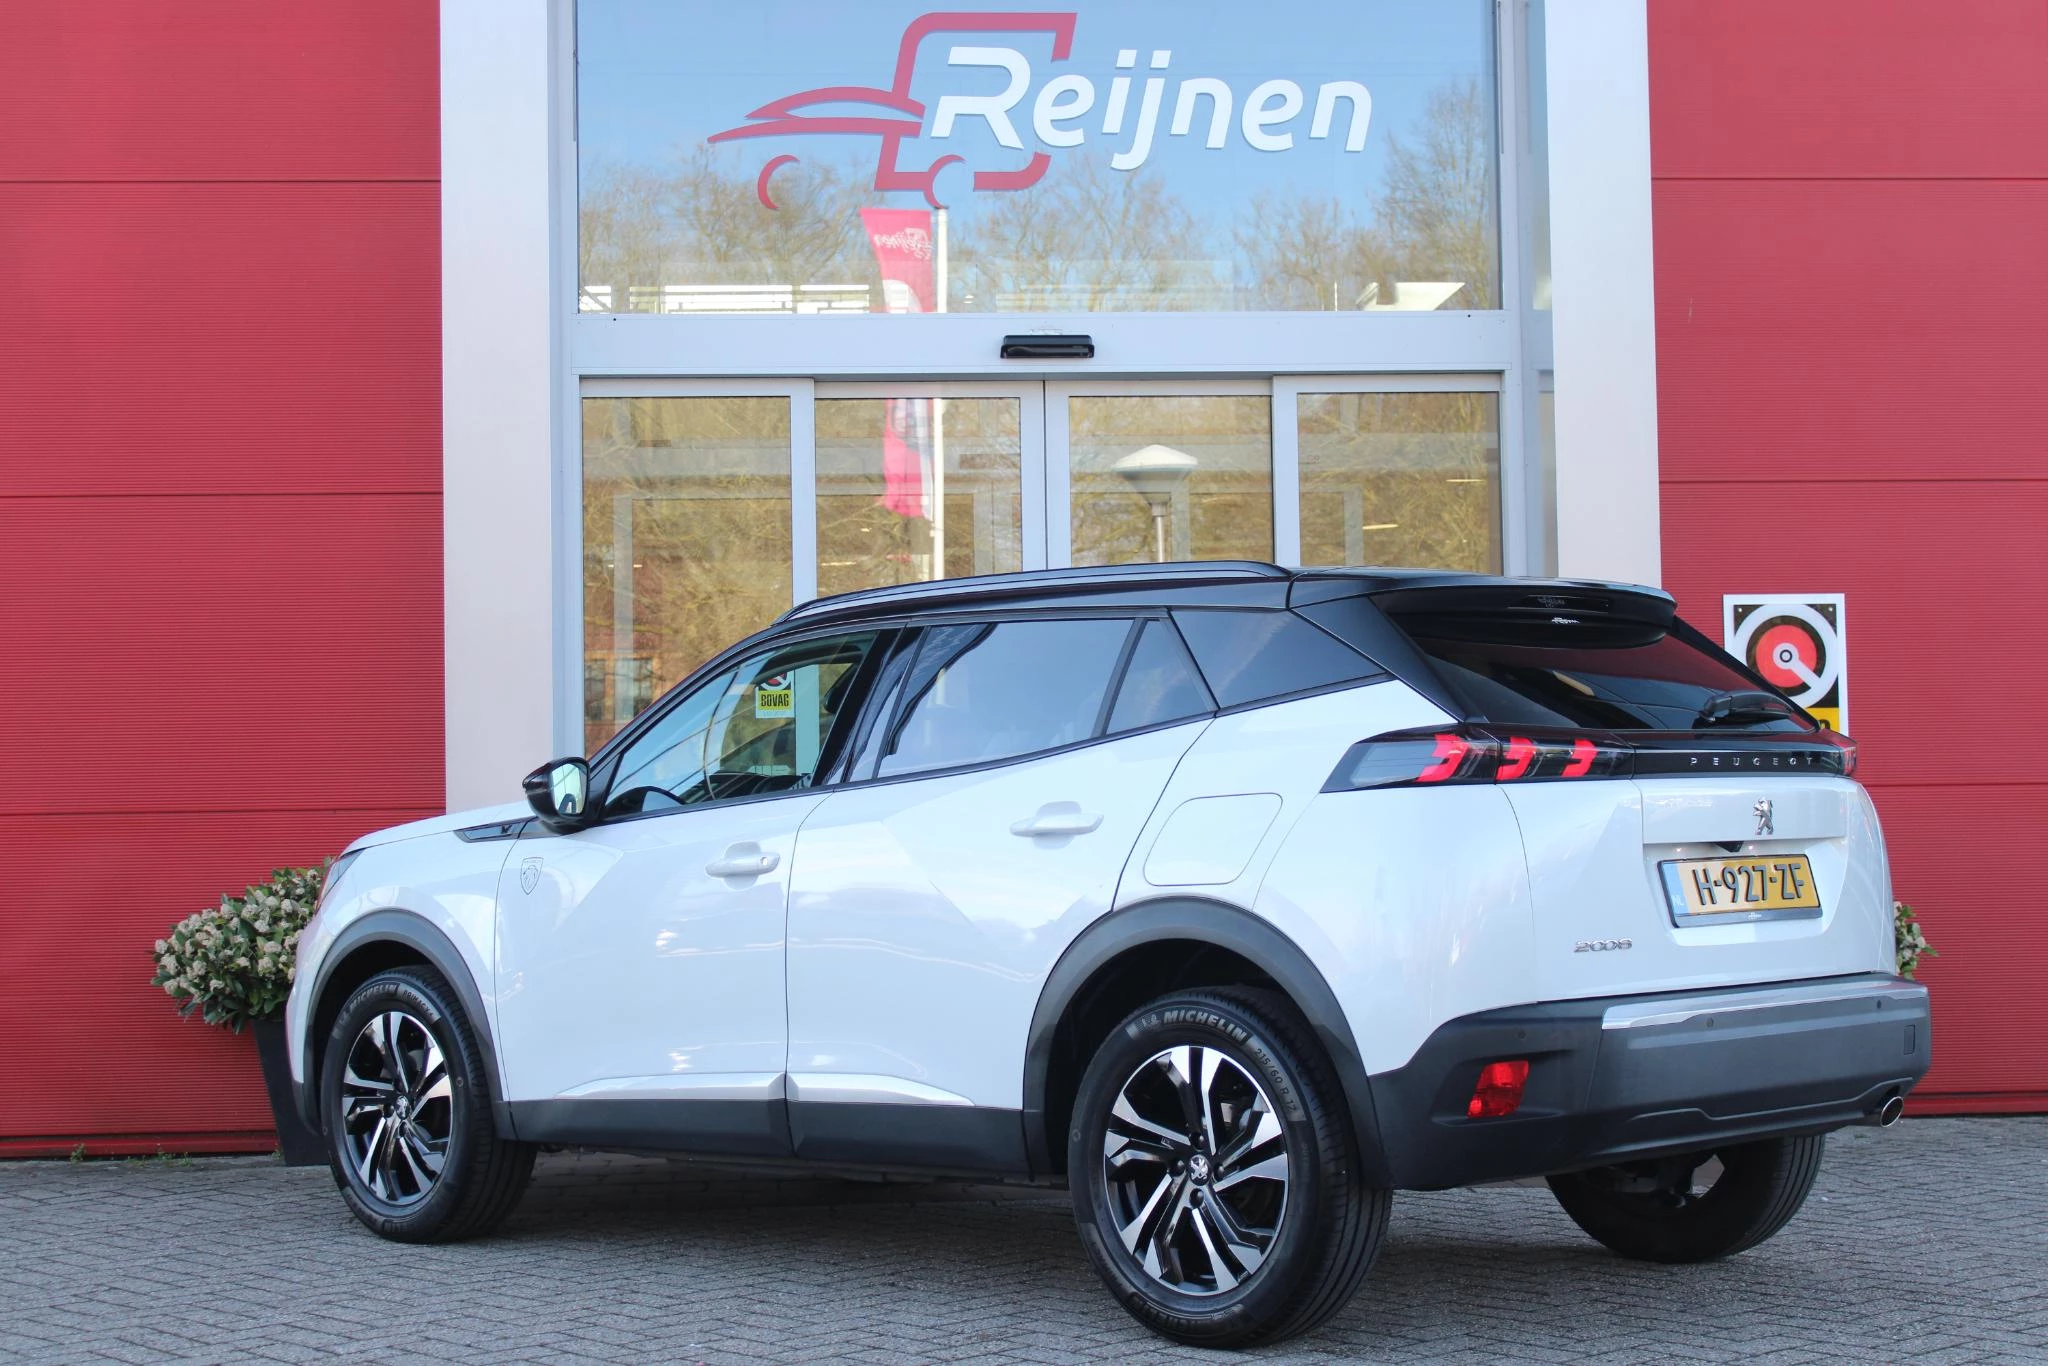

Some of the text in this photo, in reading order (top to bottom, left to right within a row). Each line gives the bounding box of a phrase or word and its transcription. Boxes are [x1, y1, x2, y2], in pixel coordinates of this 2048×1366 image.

[930, 46, 1372, 170] Reijnen
[761, 693, 789, 707] BOVAG
[1690, 757, 1813, 766] PEUGEOT
[1692, 863, 1804, 906] H-927-ZF
[1163, 1010, 1248, 1042] MICHELIN
[1255, 1047, 1283, 1084] 215/60
